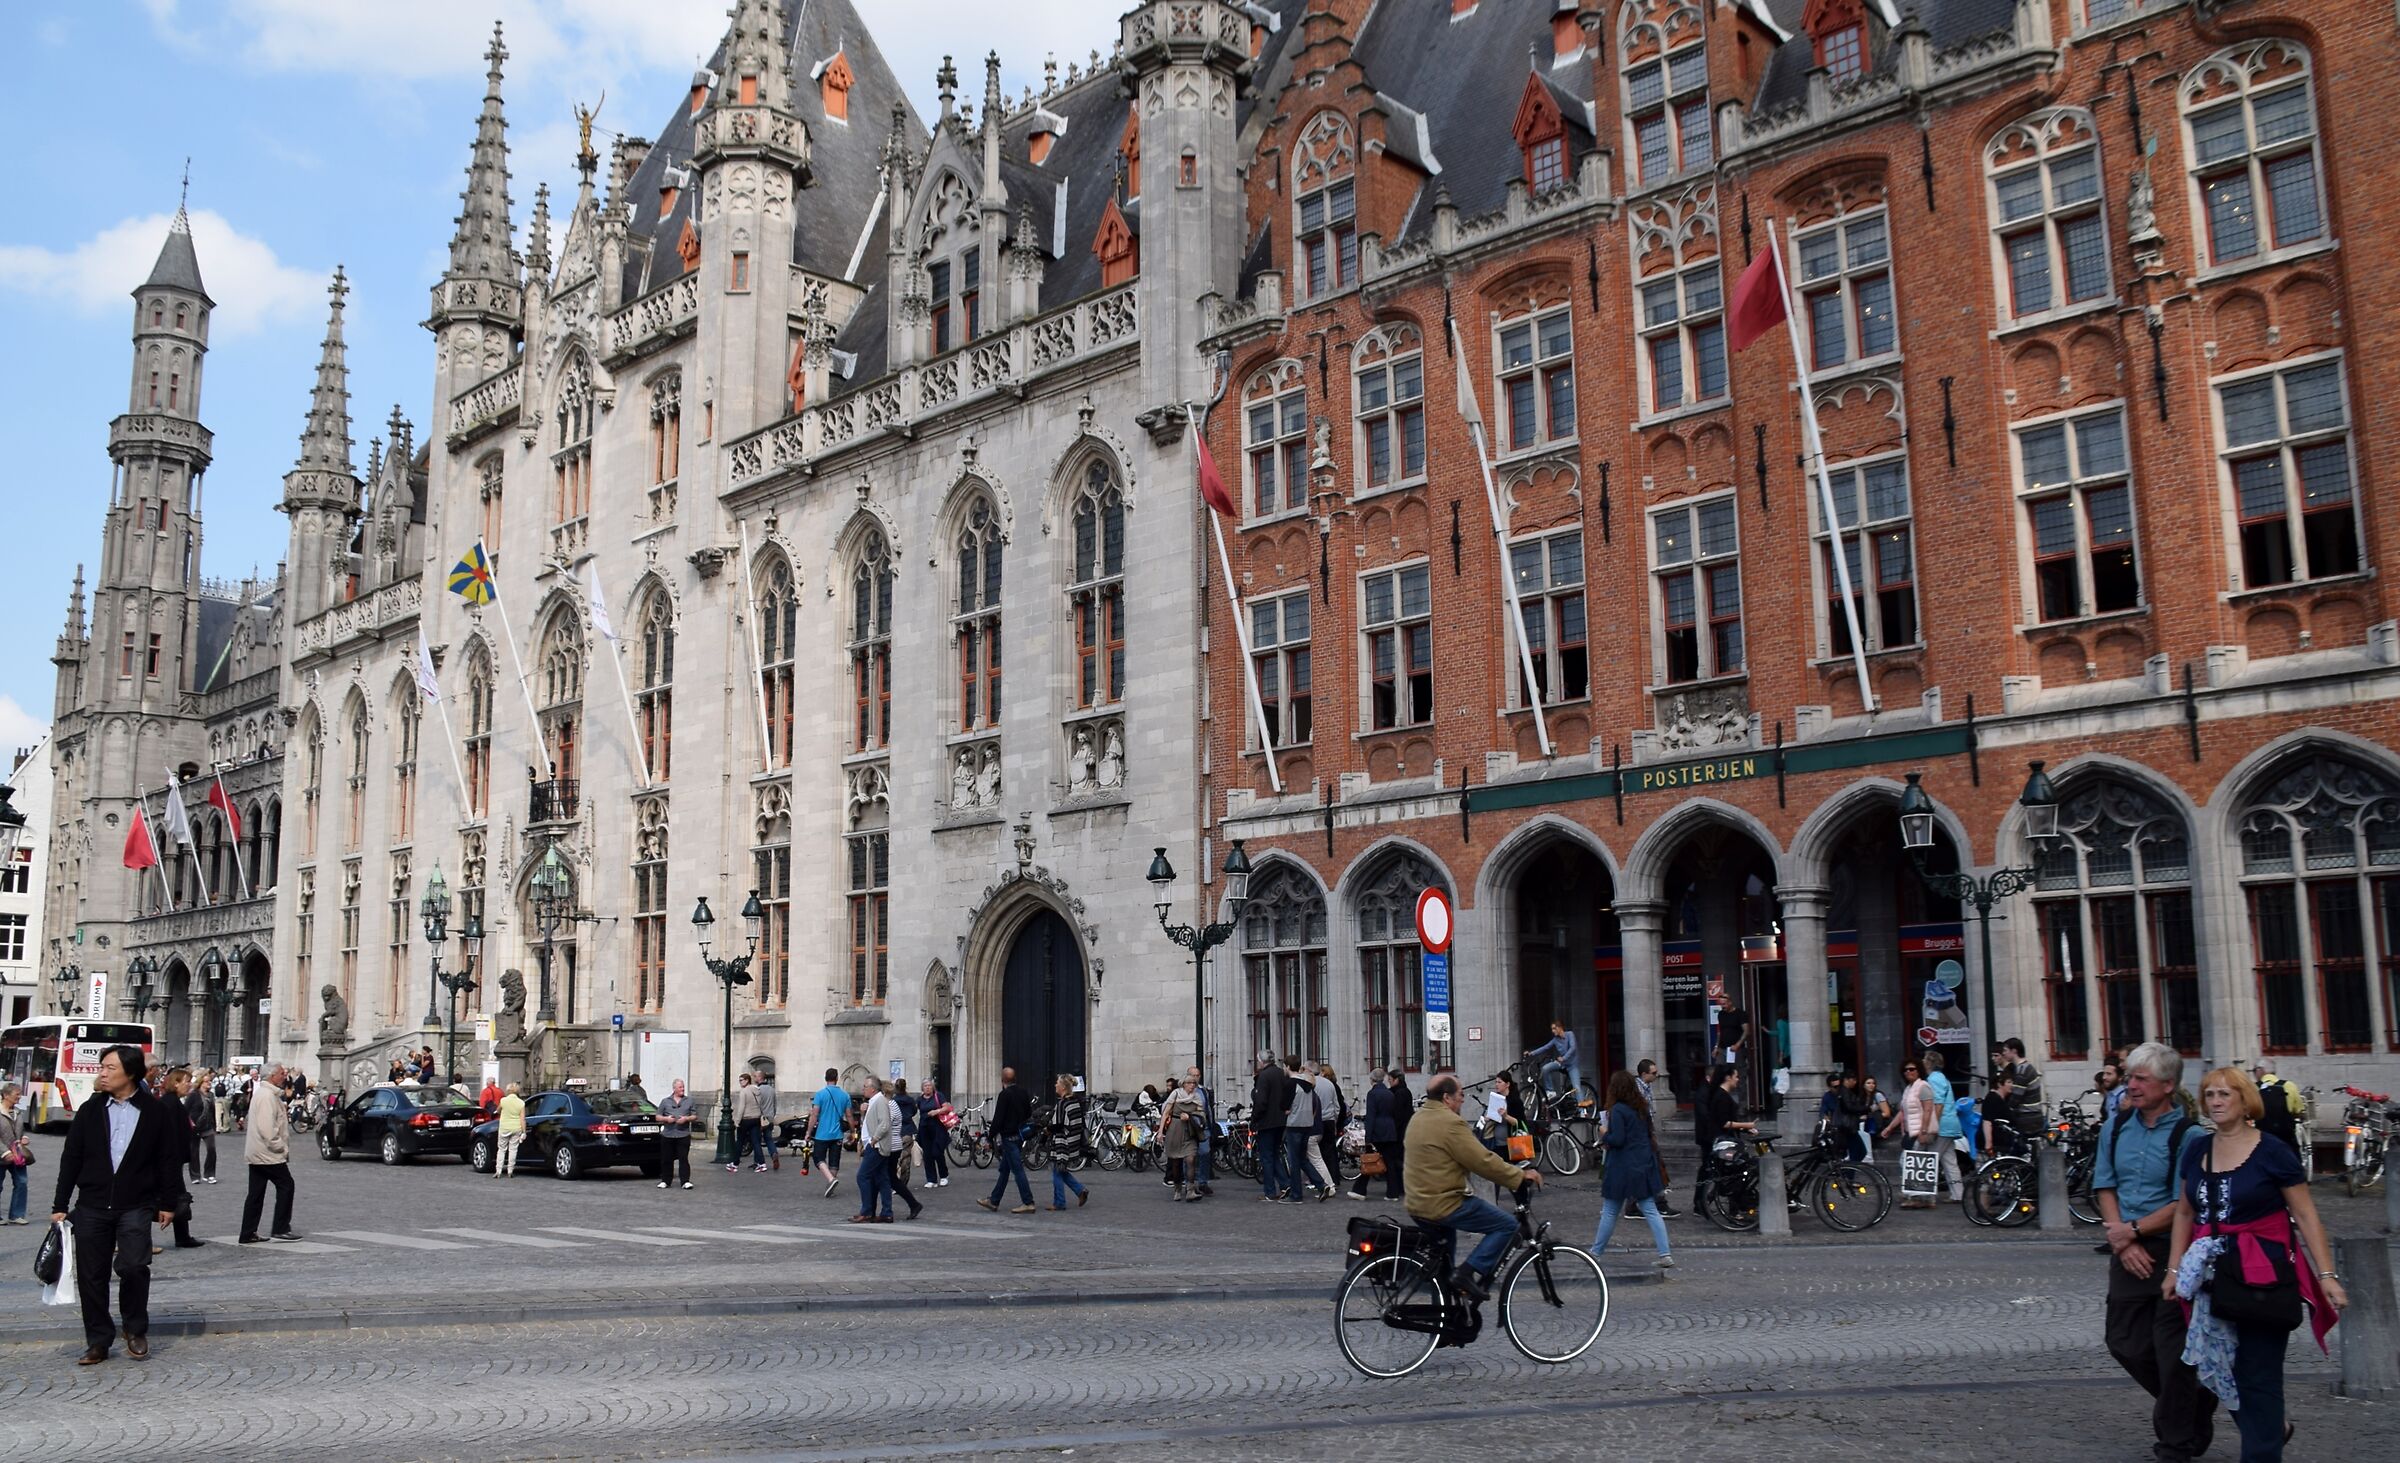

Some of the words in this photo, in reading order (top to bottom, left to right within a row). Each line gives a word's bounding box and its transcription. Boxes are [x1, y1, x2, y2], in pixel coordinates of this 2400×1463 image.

[1924, 938, 1956, 950] Brugge
[1666, 955, 1684, 963] POST
[1675, 983, 1702, 991] shoppen
[1906, 1155, 1935, 1169] ava
[1904, 1169, 1936, 1182] nce
